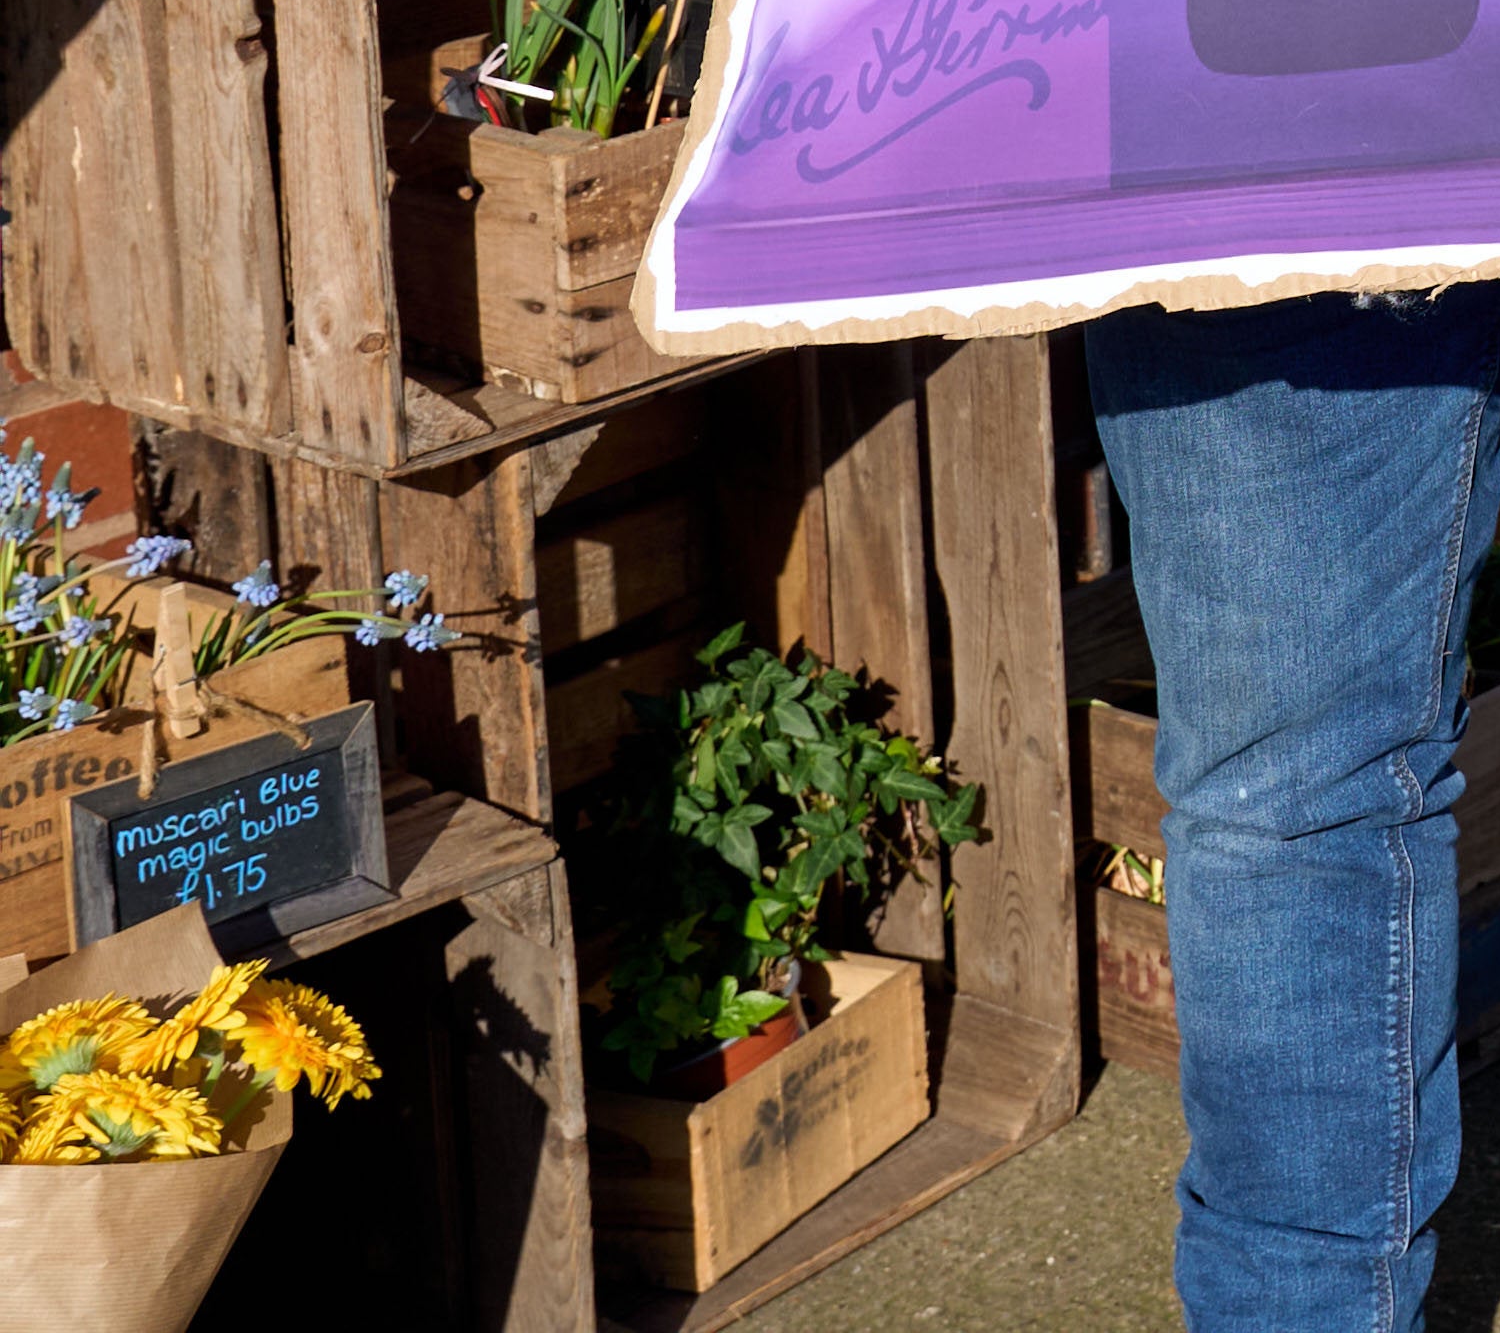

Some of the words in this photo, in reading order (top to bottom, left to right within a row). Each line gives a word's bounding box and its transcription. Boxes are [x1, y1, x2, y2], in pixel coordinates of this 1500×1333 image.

[0, 751, 133, 809] offee
[116, 789, 247, 859] muscari
[259, 767, 321, 805] Blue
[138, 832, 230, 884] magic
[241, 795, 320, 843] bulbs
[175, 853, 268, 910] £1.75
